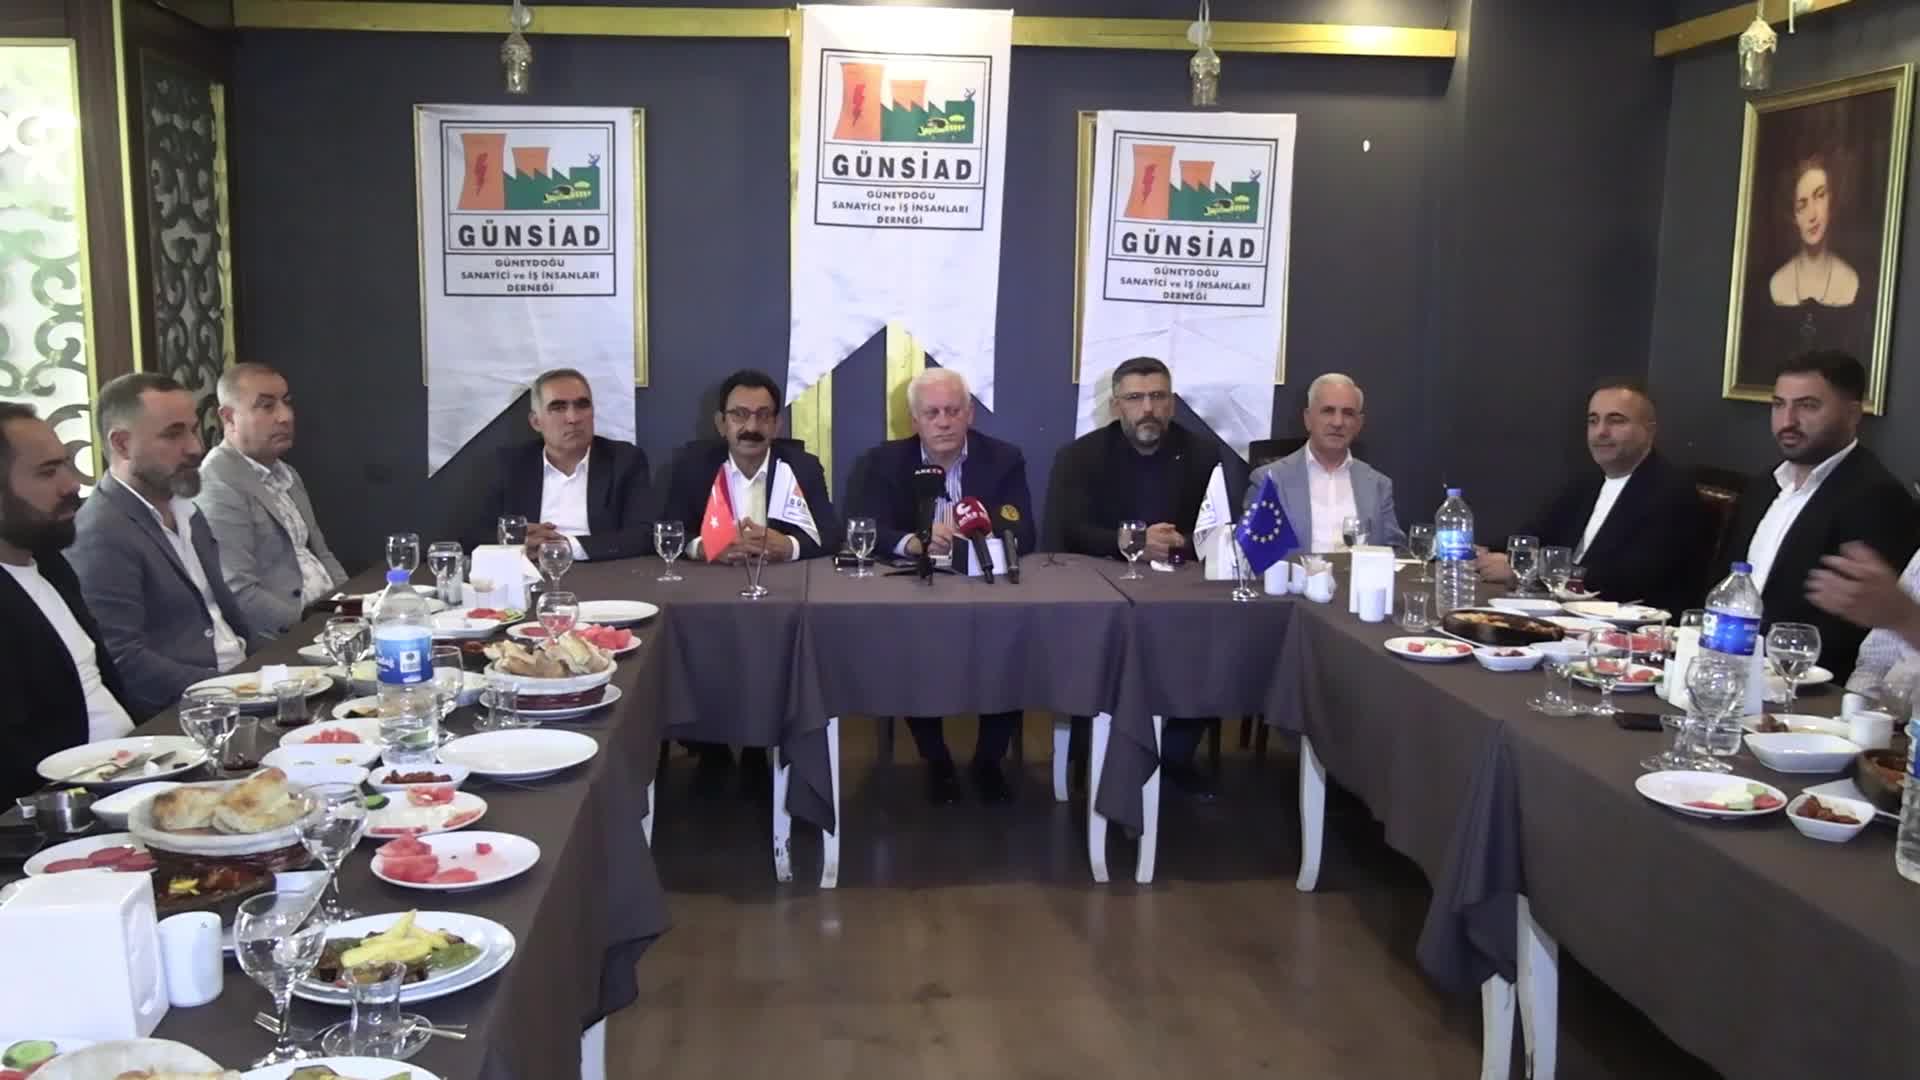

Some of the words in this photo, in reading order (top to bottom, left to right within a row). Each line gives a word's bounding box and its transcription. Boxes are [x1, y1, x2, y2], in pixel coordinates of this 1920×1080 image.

[832, 150, 972, 180] GÜNSİAD
[866, 190, 936, 200] GÜNEYDOĞU
[832, 201, 881, 211] SANAYİCİ
[911, 204, 969, 213] İNSANLARI
[876, 215, 923, 224] DERNEĞİ
[458, 218, 601, 247] GÜNSİAD
[1122, 228, 1256, 259] GÜNSİAD
[495, 258, 565, 267] GÜNEYDOĞU
[461, 271, 511, 280] SANAYİCİ
[528, 271, 538, 281] İŞ
[541, 271, 600, 280] İNSANLARI
[1154, 267, 1219, 277] GÜNEYDOĞU
[1120, 277, 1167, 287] SANAYİCİ
[507, 283, 554, 292] DERNEĞİ
[1163, 292, 1207, 301] DERNEĞİ
